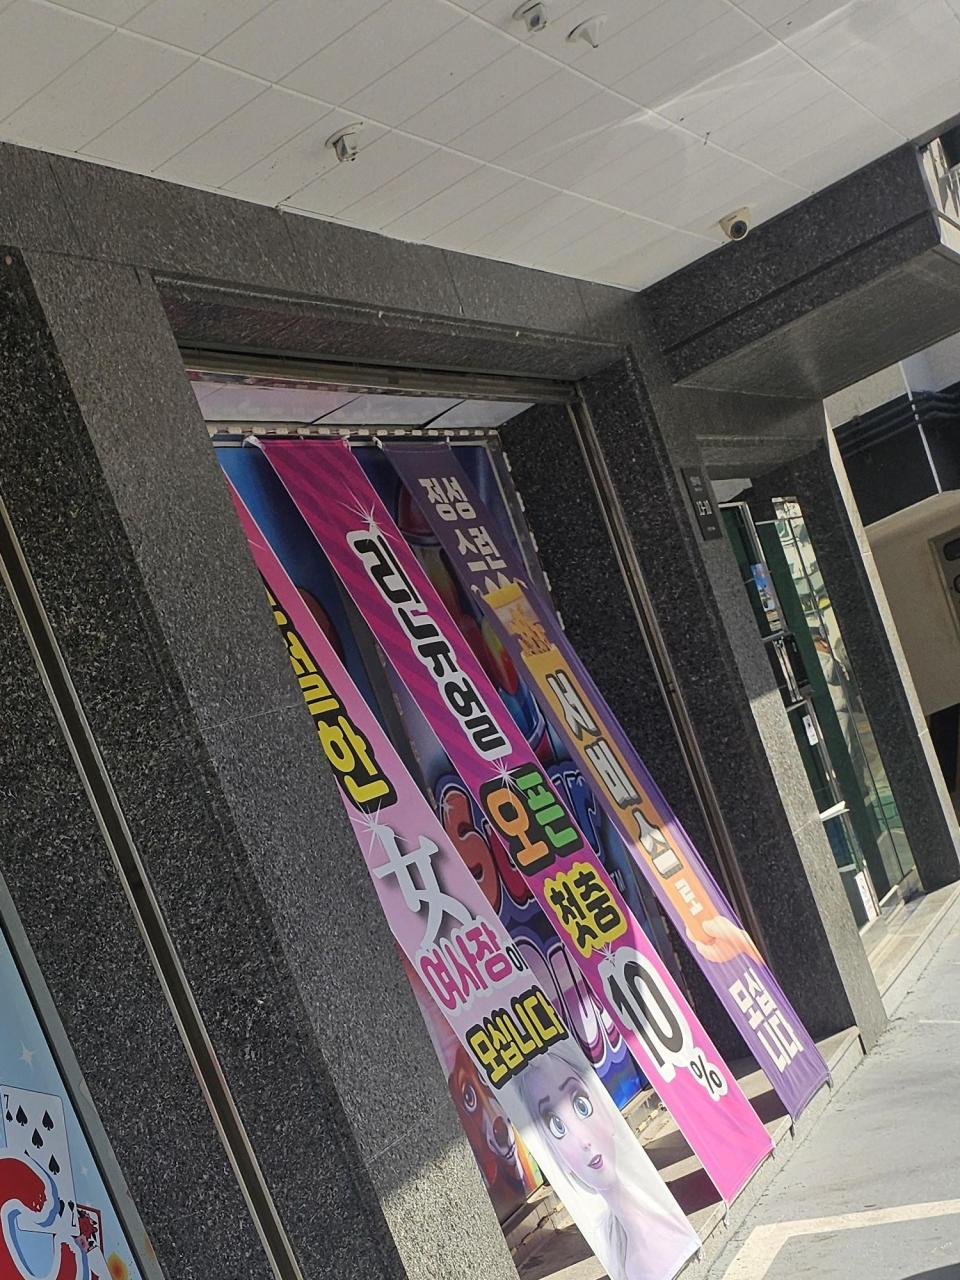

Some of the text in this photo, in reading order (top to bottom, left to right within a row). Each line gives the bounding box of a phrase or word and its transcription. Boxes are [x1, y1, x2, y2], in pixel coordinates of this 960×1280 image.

[418, 476, 478, 521] 정성
[455, 528, 507, 573] 스런
[347, 532, 510, 757] 리뉴얼
[481, 765, 582, 872] 오픈
[373, 822, 477, 950] 女
[547, 867, 623, 951] 첫충
[420, 921, 530, 1011] 여사장이
[728, 966, 774, 1030] 모십
[467, 988, 567, 1086] 모십니다
[607, 962, 724, 1093] 10%
[755, 1010, 807, 1074] 니다
[2, 1093, 11, 1110] 7
